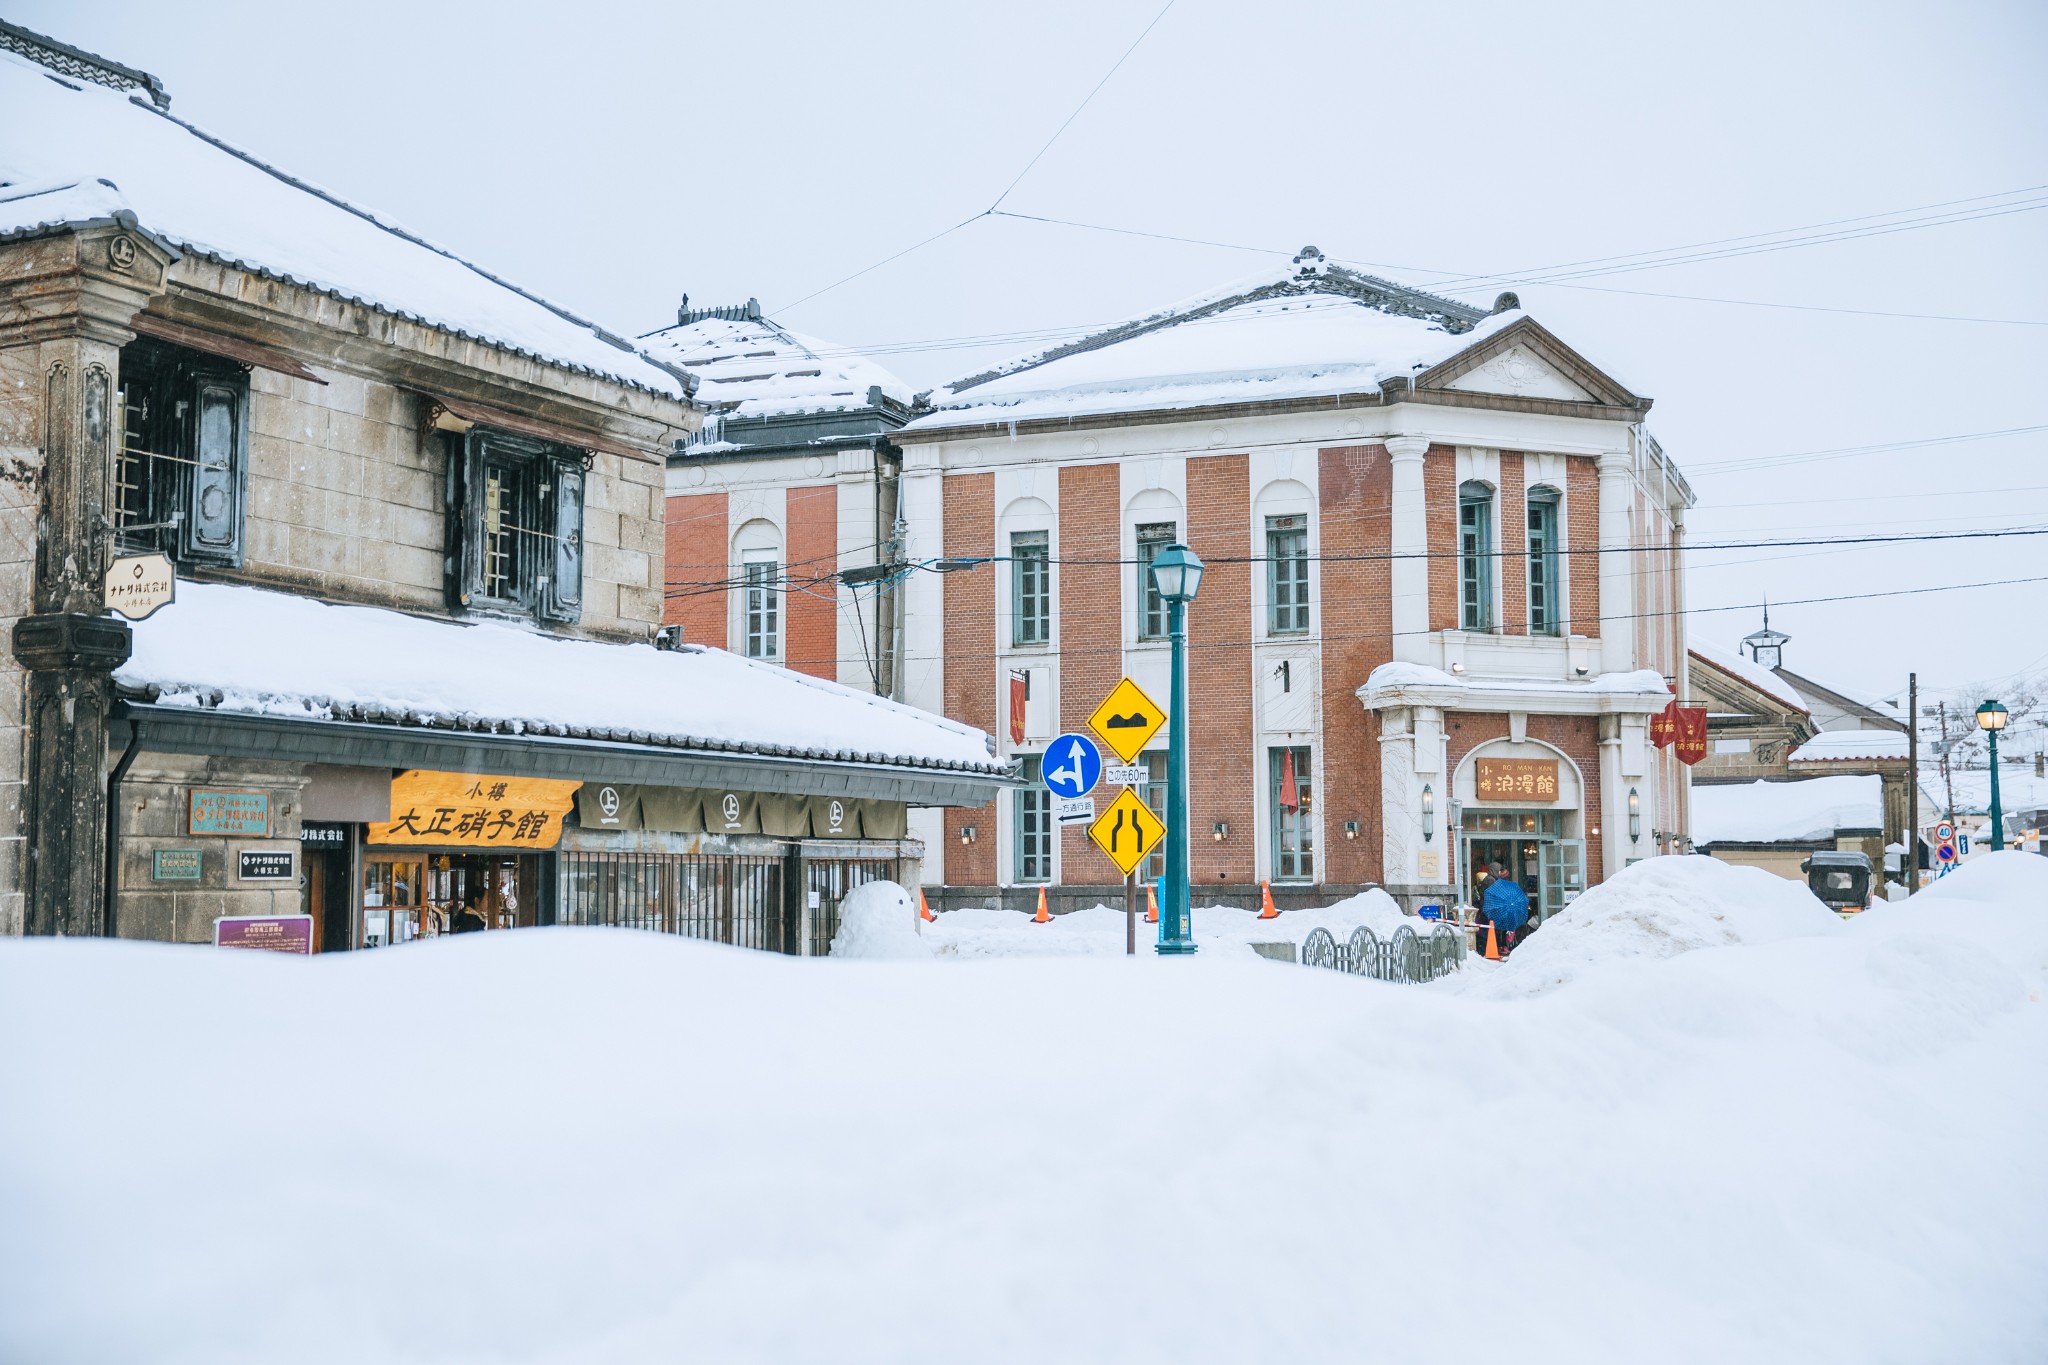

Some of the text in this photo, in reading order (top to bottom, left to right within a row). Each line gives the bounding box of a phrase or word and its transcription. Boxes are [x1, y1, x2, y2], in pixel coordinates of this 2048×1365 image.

[110, 581, 168, 597] ナトリ株式会社
[1516, 764, 1533, 772] MAN
[1108, 769, 1147, 782] この先60m
[1480, 765, 1493, 792] 小樽
[1495, 774, 1555, 794] 浪漫館
[465, 781, 509, 801] 小樽
[1055, 801, 1093, 813] 一方通行路
[388, 807, 550, 841] 大正硝子館
[1939, 827, 1951, 837] 40
[250, 856, 290, 865] ナトリ株式会社
[253, 866, 280, 875] 小樽支店
